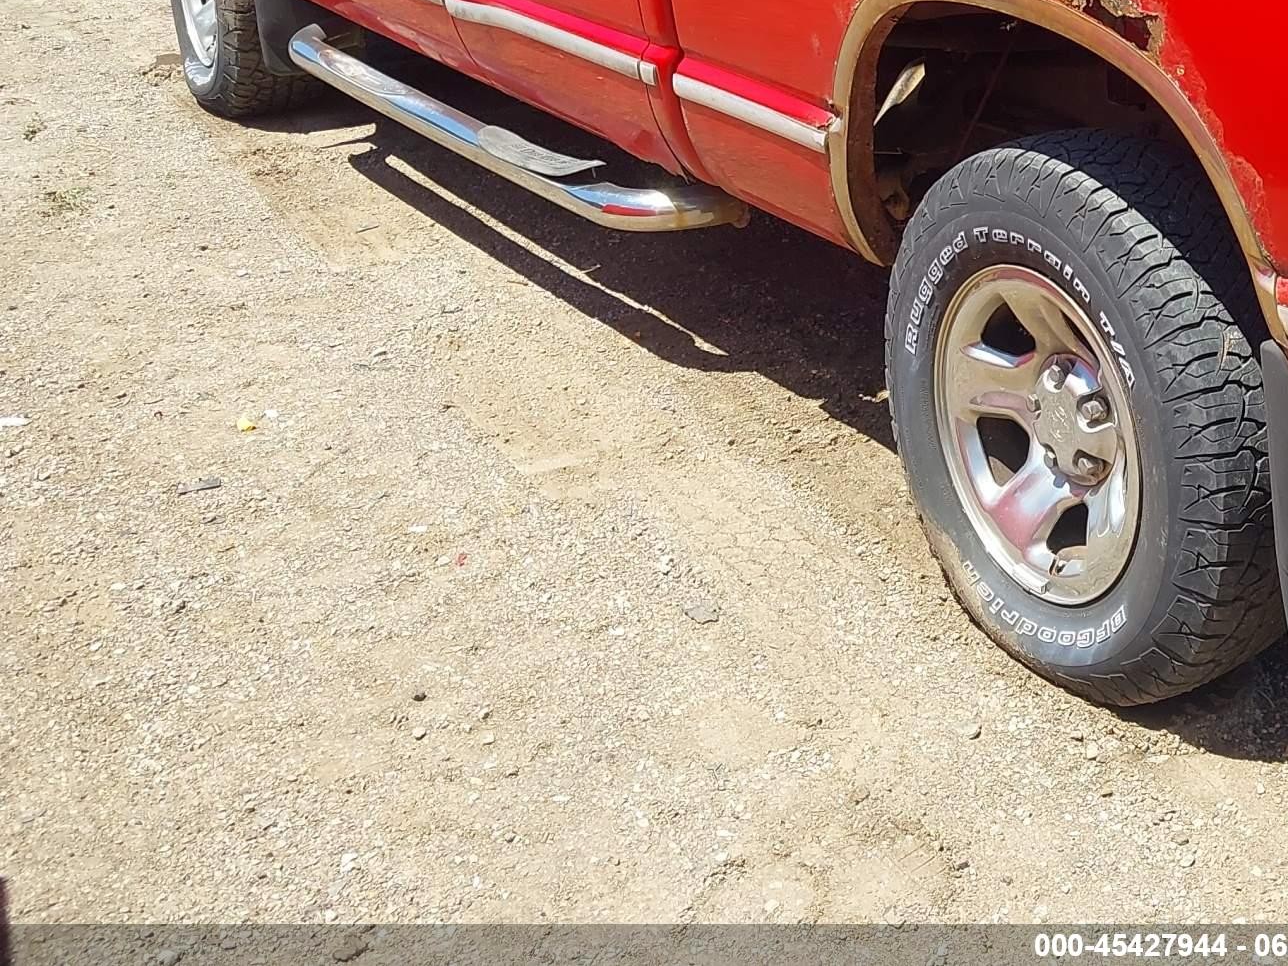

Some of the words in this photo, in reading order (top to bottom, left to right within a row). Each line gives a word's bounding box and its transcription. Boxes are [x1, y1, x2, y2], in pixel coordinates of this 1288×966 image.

[905, 231, 968, 355] Rugged
[973, 226, 1091, 304] Terrain
[1099, 310, 1136, 392] T/A
[962, 561, 1127, 648] BFGoodrich
